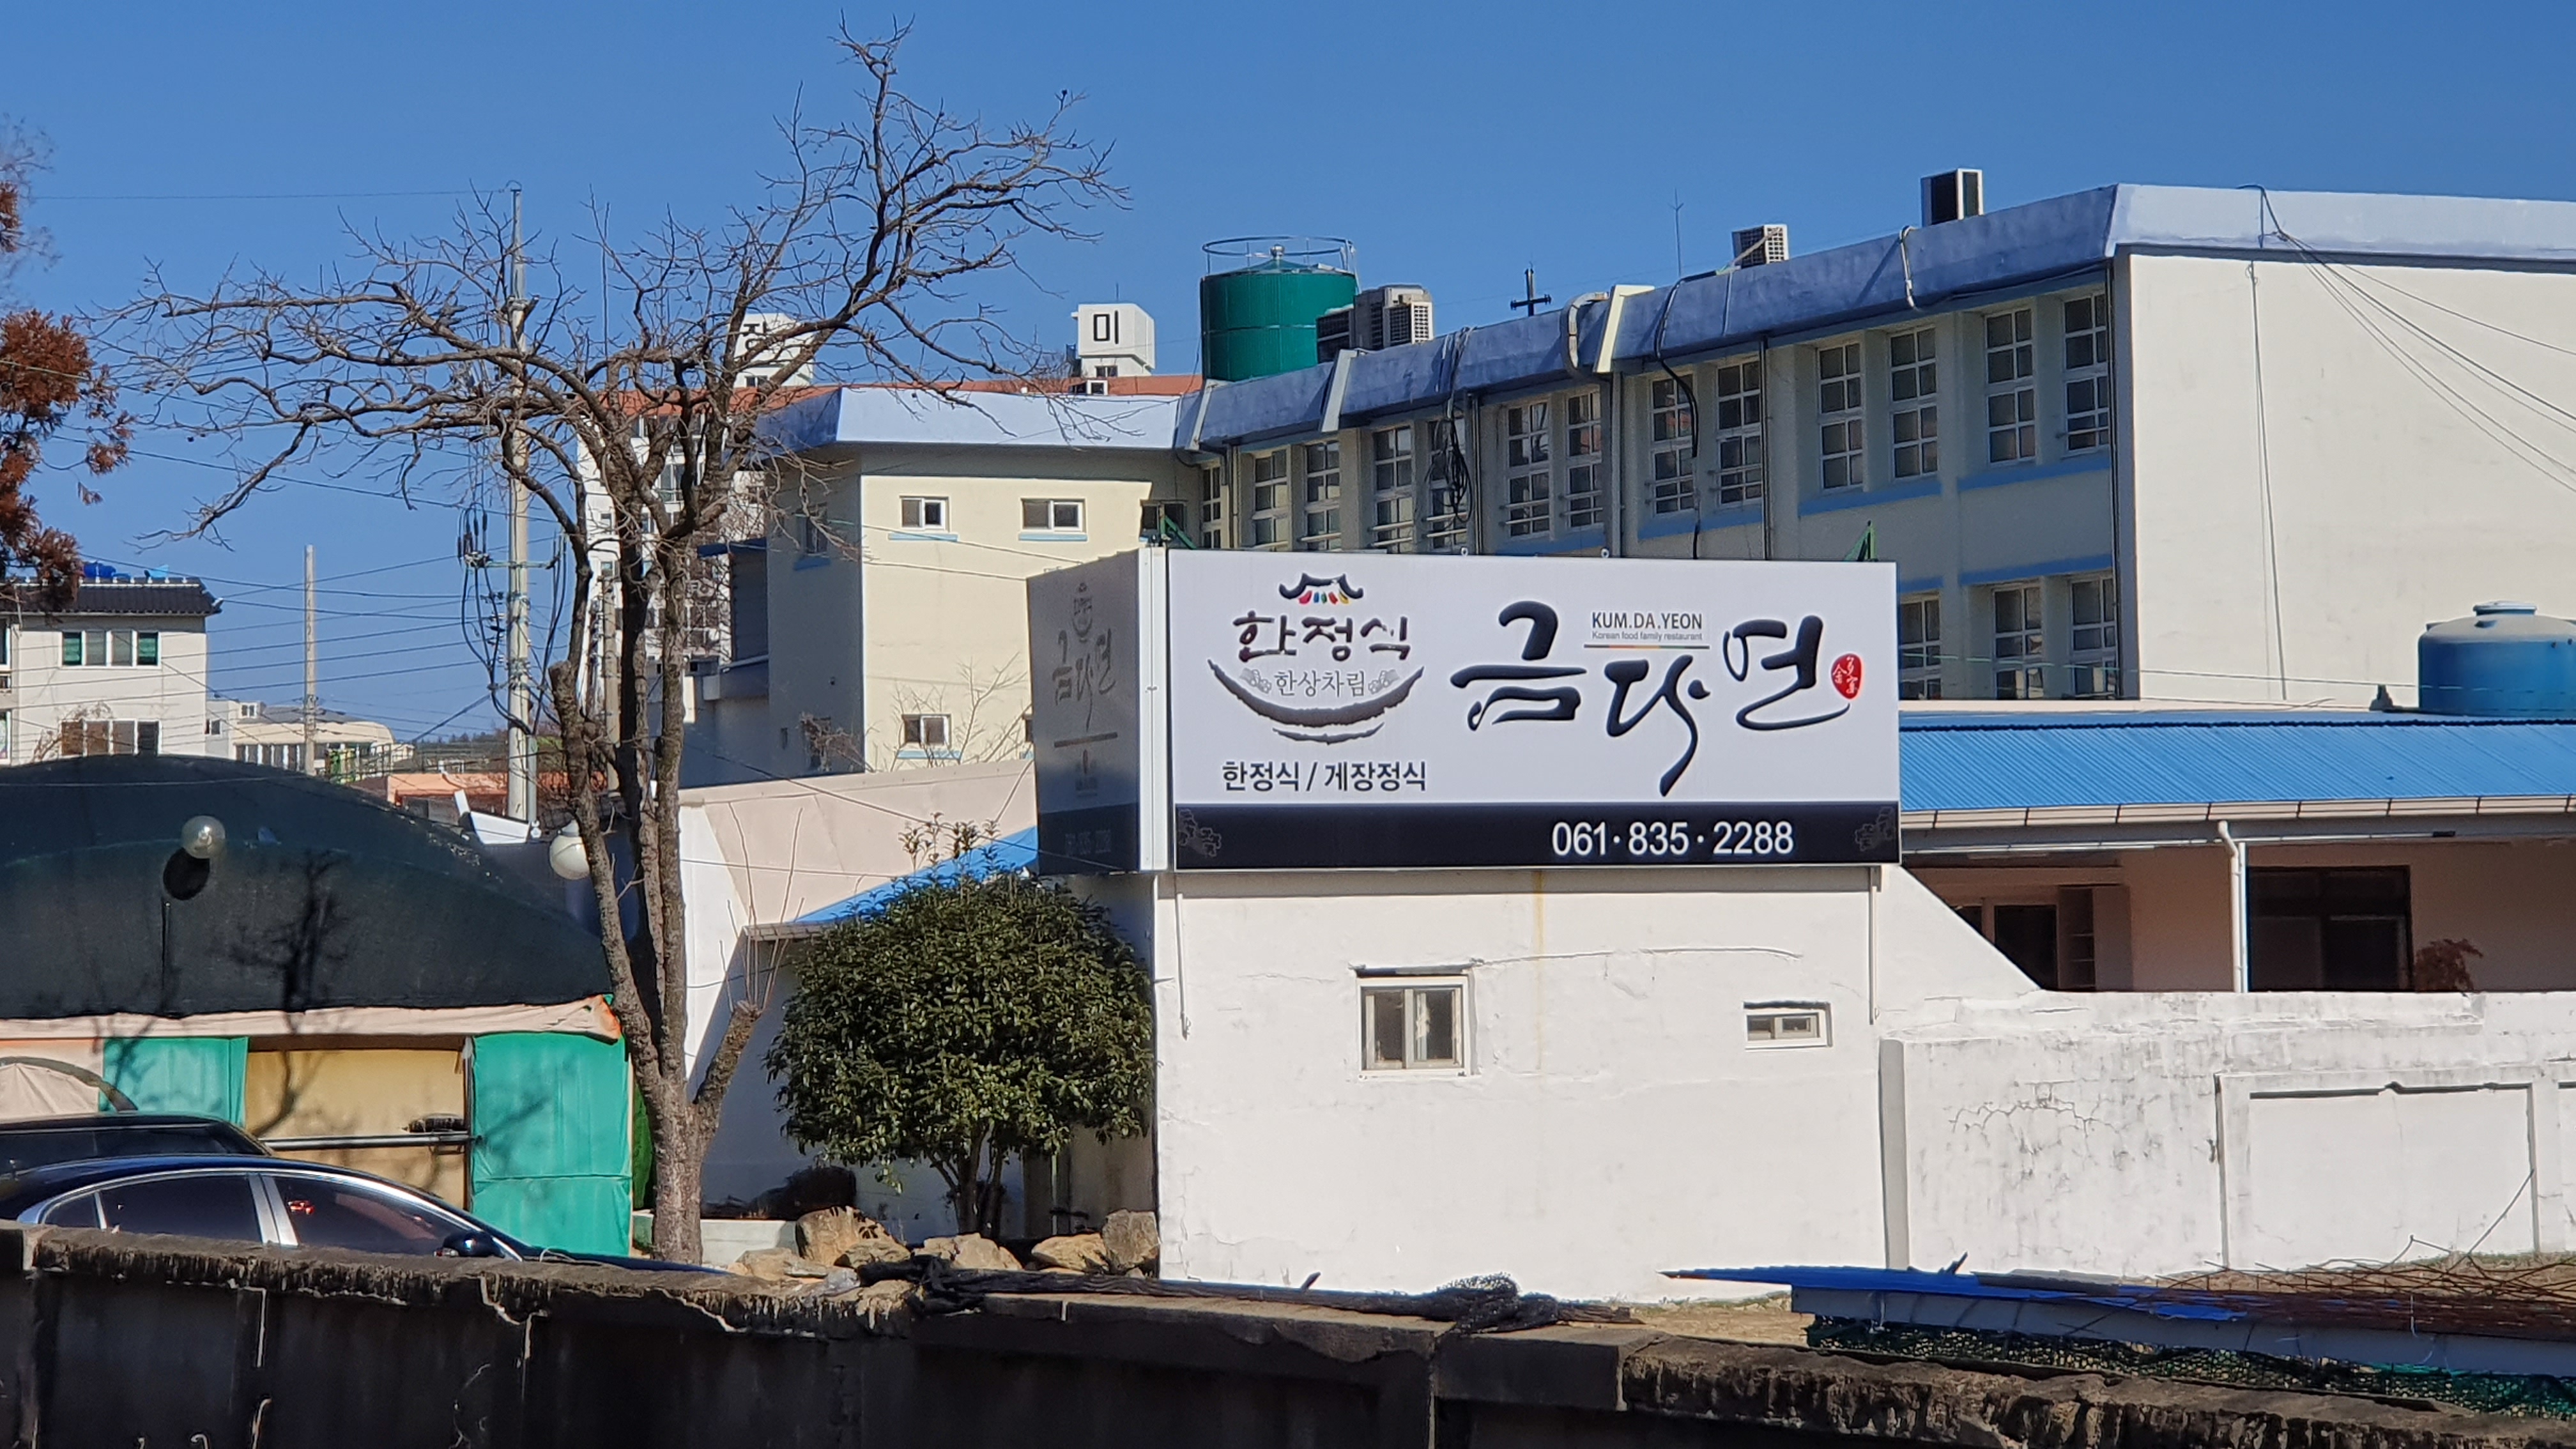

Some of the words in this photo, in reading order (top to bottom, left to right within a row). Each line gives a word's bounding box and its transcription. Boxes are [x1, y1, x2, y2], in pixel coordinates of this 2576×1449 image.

[1093, 310, 1119, 345] 미
[1232, 611, 1410, 662] 한정식
[1592, 631, 1620, 640] Korean
[1621, 631, 1638, 640] food
[1639, 631, 1662, 641] family
[1664, 632, 1703, 640] restaurant
[1274, 669, 1365, 697] 한상차림
